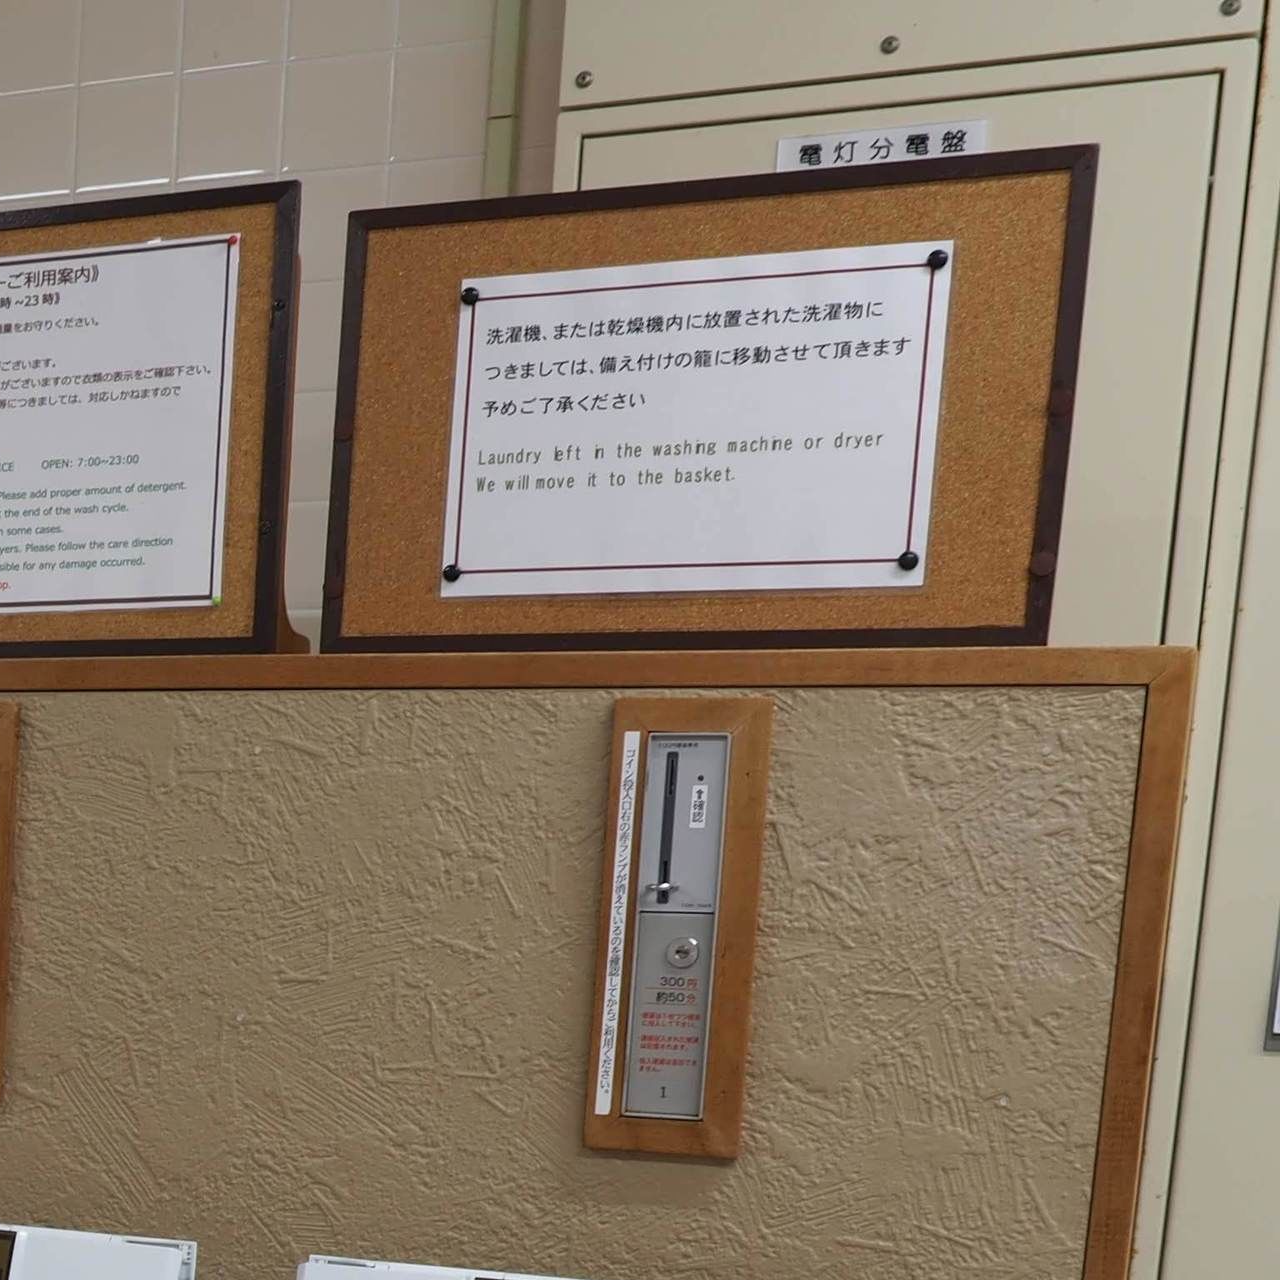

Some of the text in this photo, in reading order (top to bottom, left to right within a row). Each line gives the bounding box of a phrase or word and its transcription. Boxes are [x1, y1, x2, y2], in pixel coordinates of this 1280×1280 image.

[798, 129, 968, 166] 電灯分電盤
[485, 300, 884, 346] 洗濯機、または乾燥機内に放置された洗濯物に
[484, 336, 913, 381] つきましては、備え付けの籠に移動させて頂きます
[481, 392, 647, 419] 予めご了承ください
[477, 431, 885, 466] Laundry left in the washing machine or dryer
[40, 457, 74, 471] OPEN:
[475, 465, 736, 493] We will move it to the basket.
[28, 487, 48, 500] add
[49, 487, 83, 500] proper
[83, 484, 123, 497] amount
[123, 482, 136, 495] of
[136, 480, 187, 494] detergent.
[3, 508, 21, 519] the
[21, 506, 42, 518] end
[41, 505, 54, 517] of
[54, 505, 72, 517] the
[73, 503, 100, 515] wash
[101, 501, 130, 515] cycle.
[5, 526, 33, 537] some
[34, 525, 64, 536] cases.
[24, 542, 57, 553] Please
[57, 540, 88, 552] follow
[88, 539, 106, 551] the
[106, 539, 130, 550] care
[130, 536, 174, 549] direction
[21, 560, 37, 572] for
[37, 561, 58, 572] any
[58, 559, 99, 571] damage
[99, 555, 146, 568] occurred.
[691, 801, 705, 824] 確認
[655, 991, 697, 1004] 約50分
